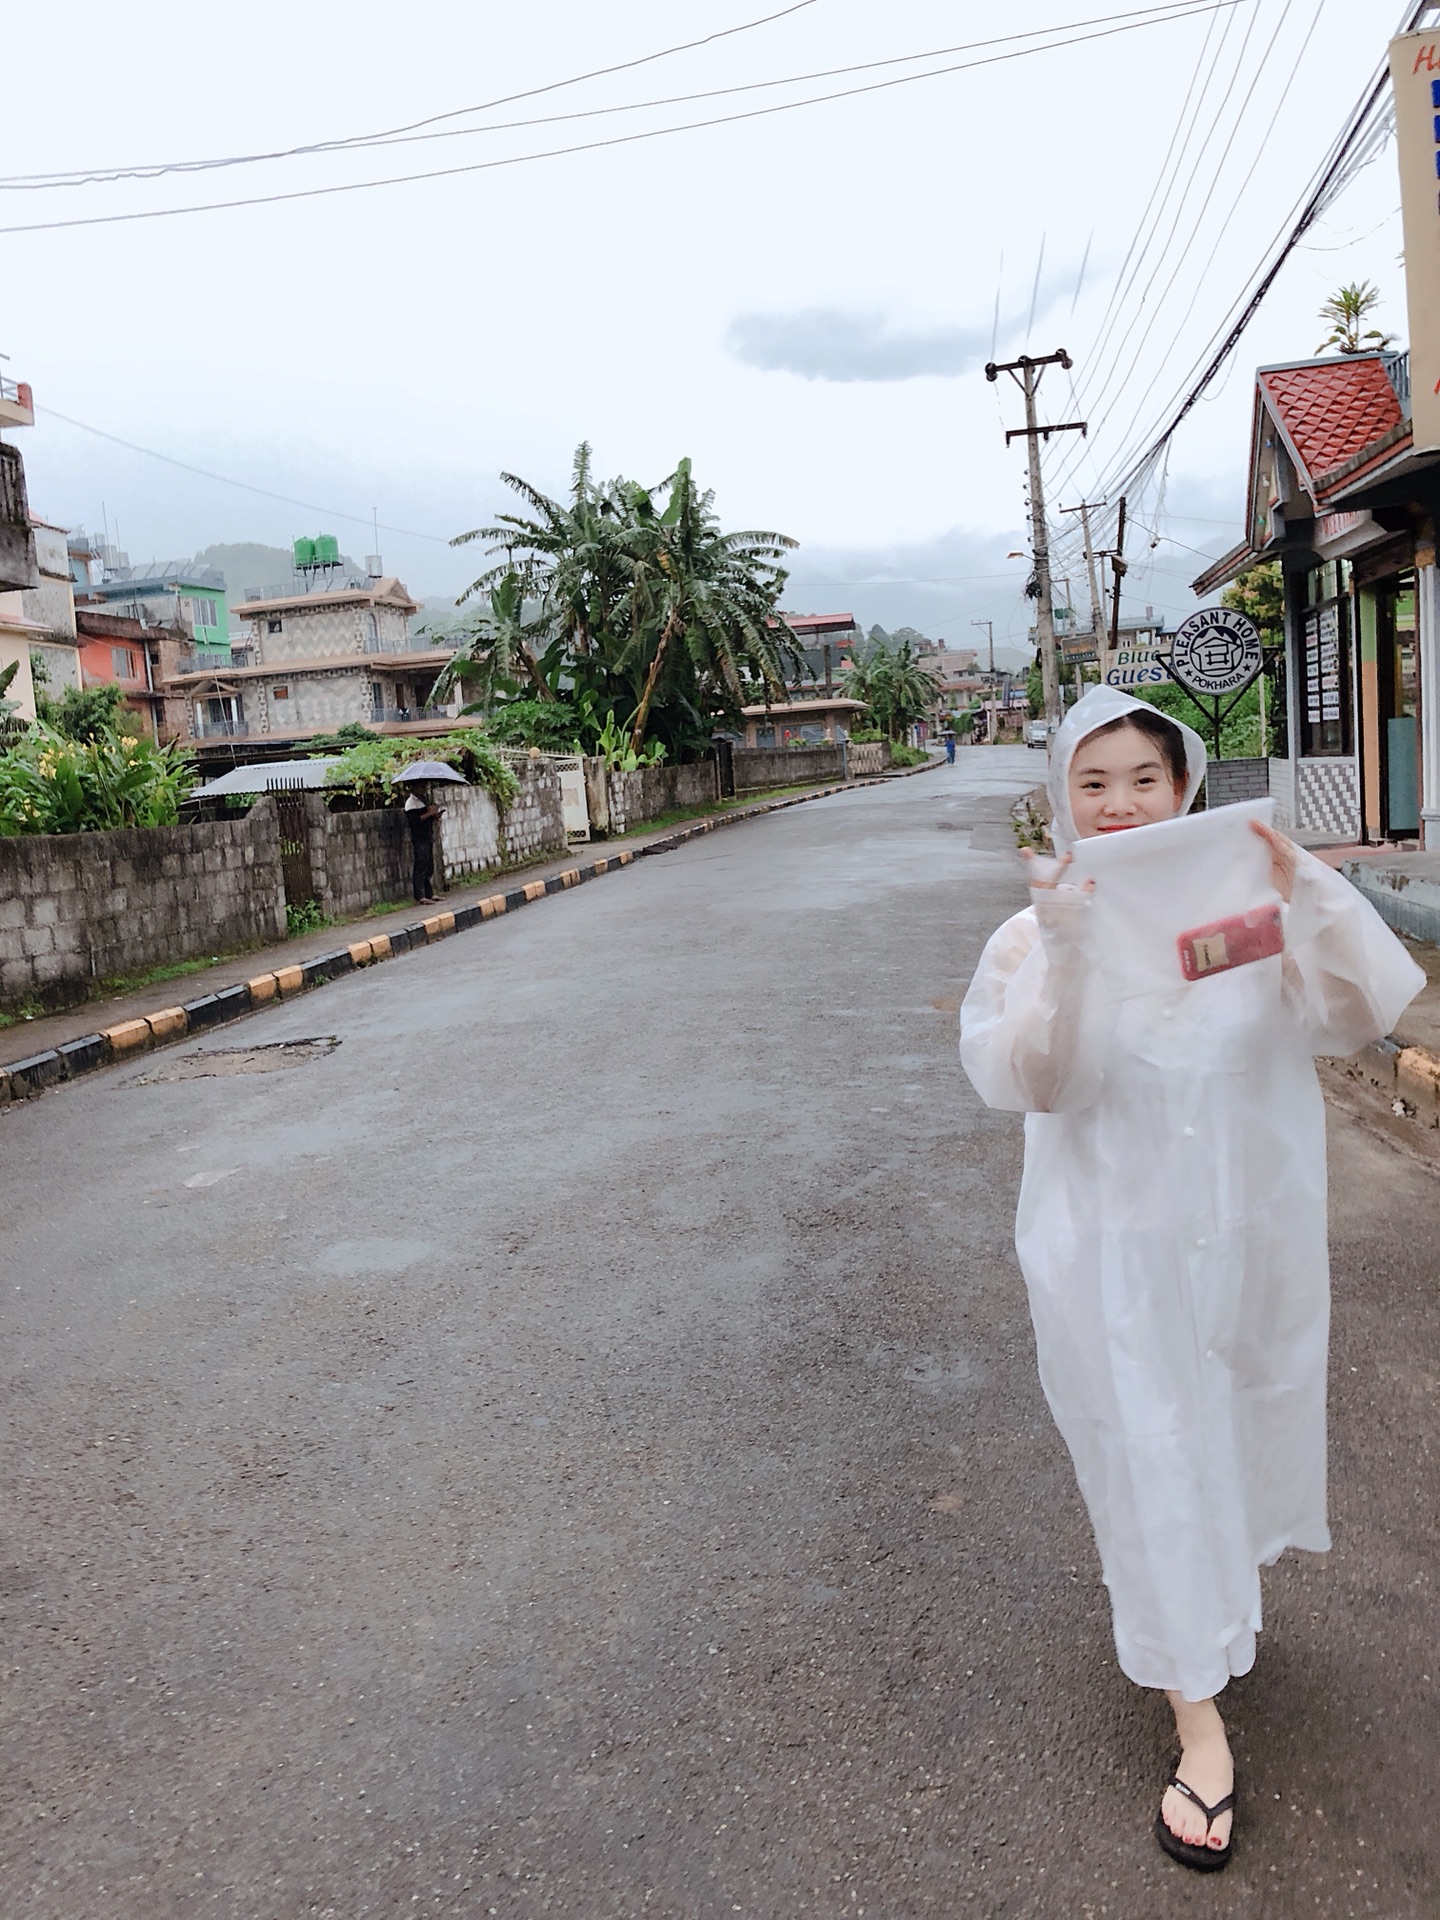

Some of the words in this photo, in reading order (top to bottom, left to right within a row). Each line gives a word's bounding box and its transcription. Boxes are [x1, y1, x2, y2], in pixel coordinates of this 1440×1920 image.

[1175, 611, 1231, 667] PLEASANT
[1233, 617, 1260, 660] HOME
[1191, 672, 1245, 690] POKHARA
